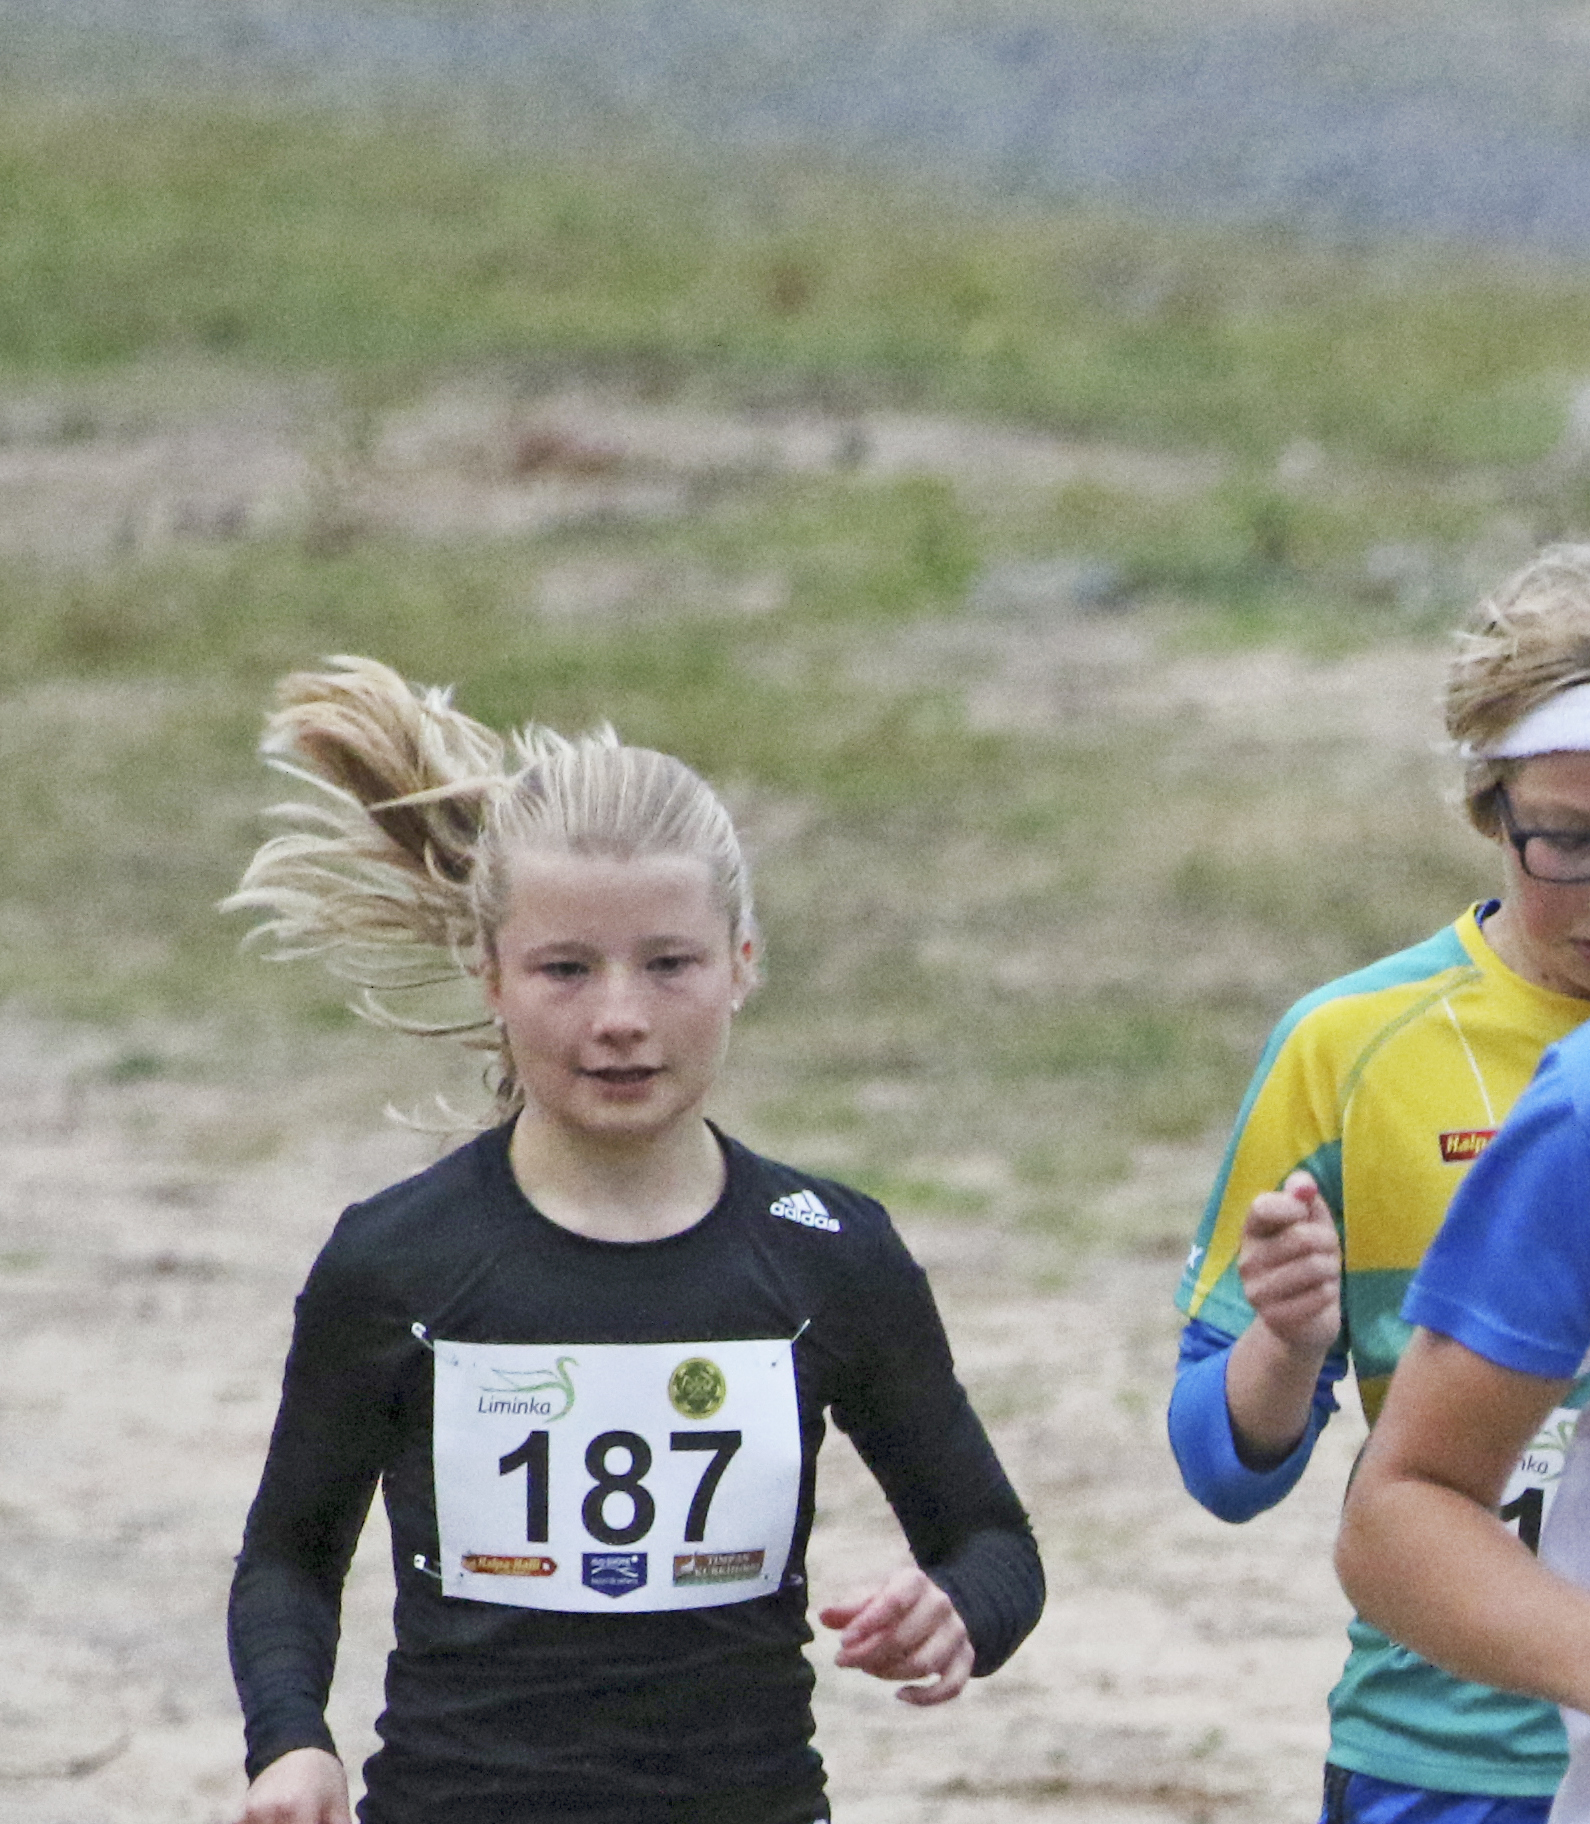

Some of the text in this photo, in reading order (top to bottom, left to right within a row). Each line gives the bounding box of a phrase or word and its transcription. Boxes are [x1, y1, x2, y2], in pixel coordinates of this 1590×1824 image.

[769, 1201, 840, 1233] adidas
[477, 1396, 551, 1416] Liminka
[499, 1429, 742, 1546] 187
